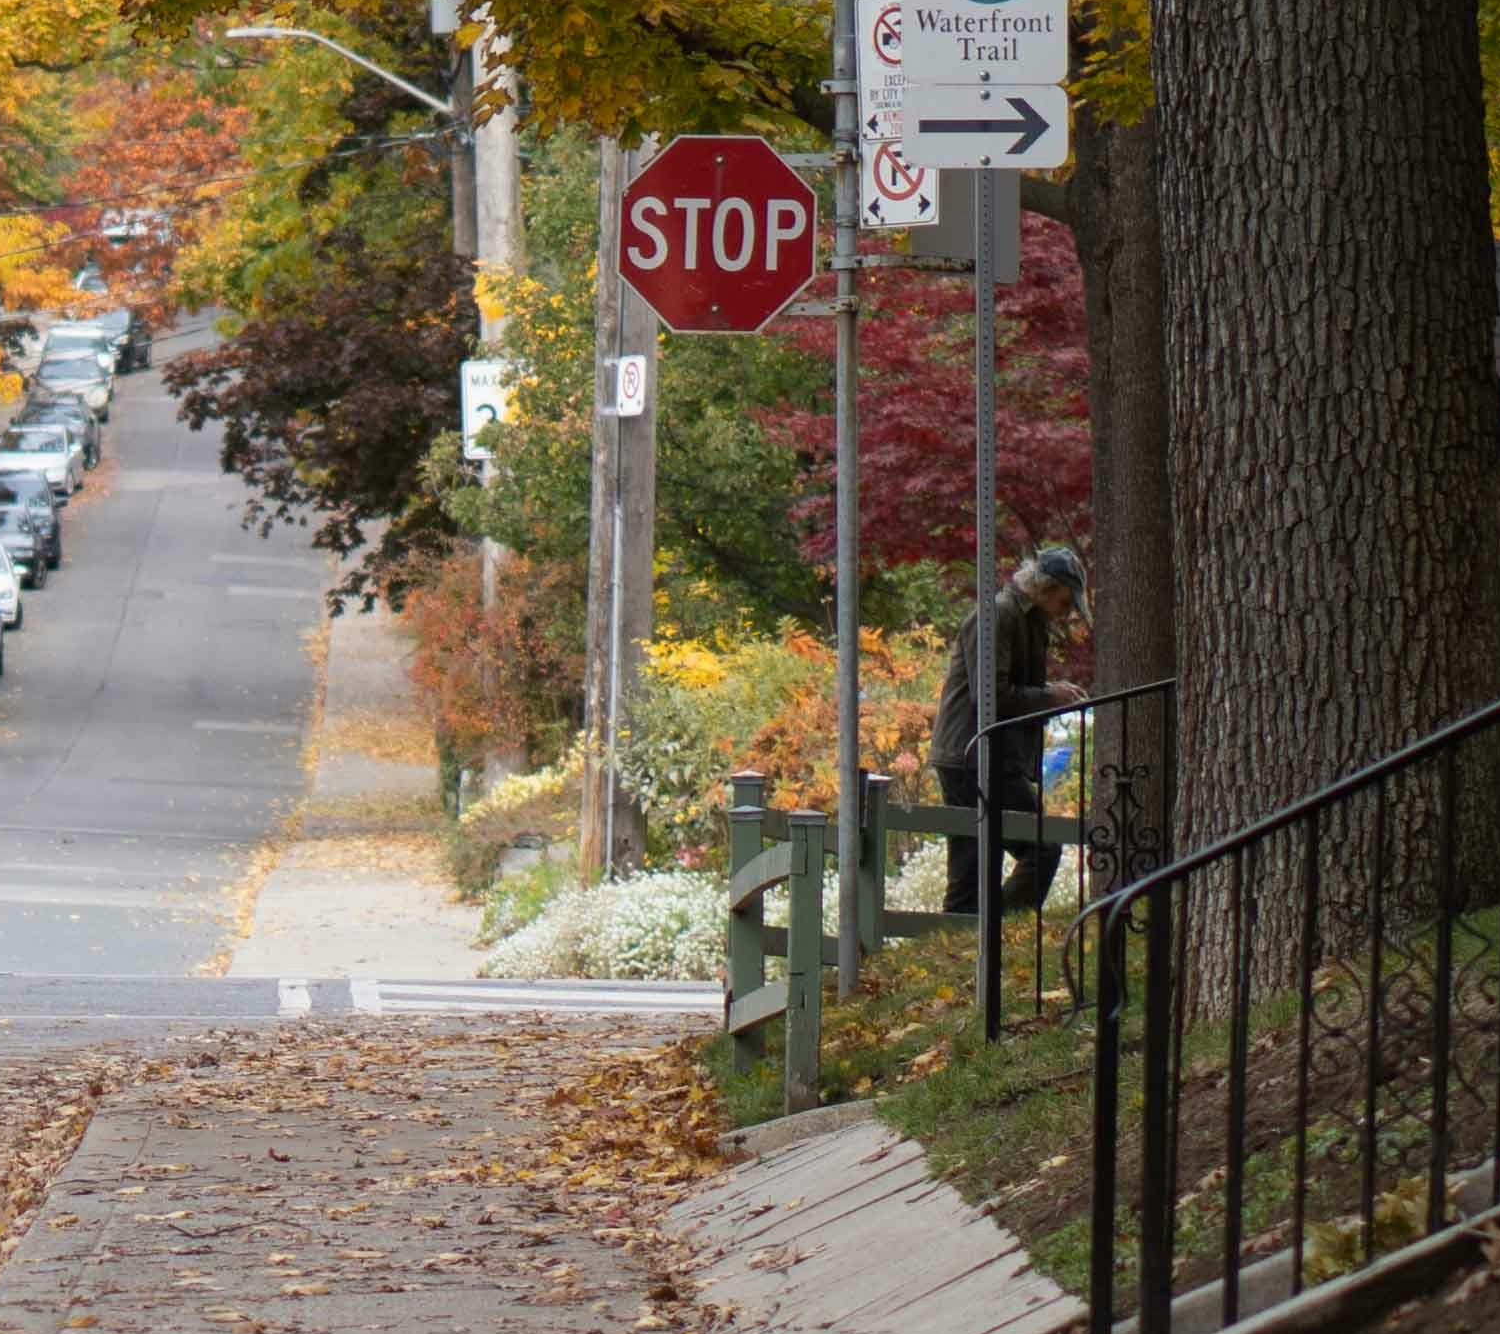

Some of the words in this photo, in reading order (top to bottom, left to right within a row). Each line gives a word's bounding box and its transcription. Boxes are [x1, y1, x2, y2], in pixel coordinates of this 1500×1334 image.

[915, 9, 1053, 33] Waterfront
[957, 37, 1019, 61] Trail
[882, 88, 899, 100] CITY
[627, 196, 806, 271] STOP
